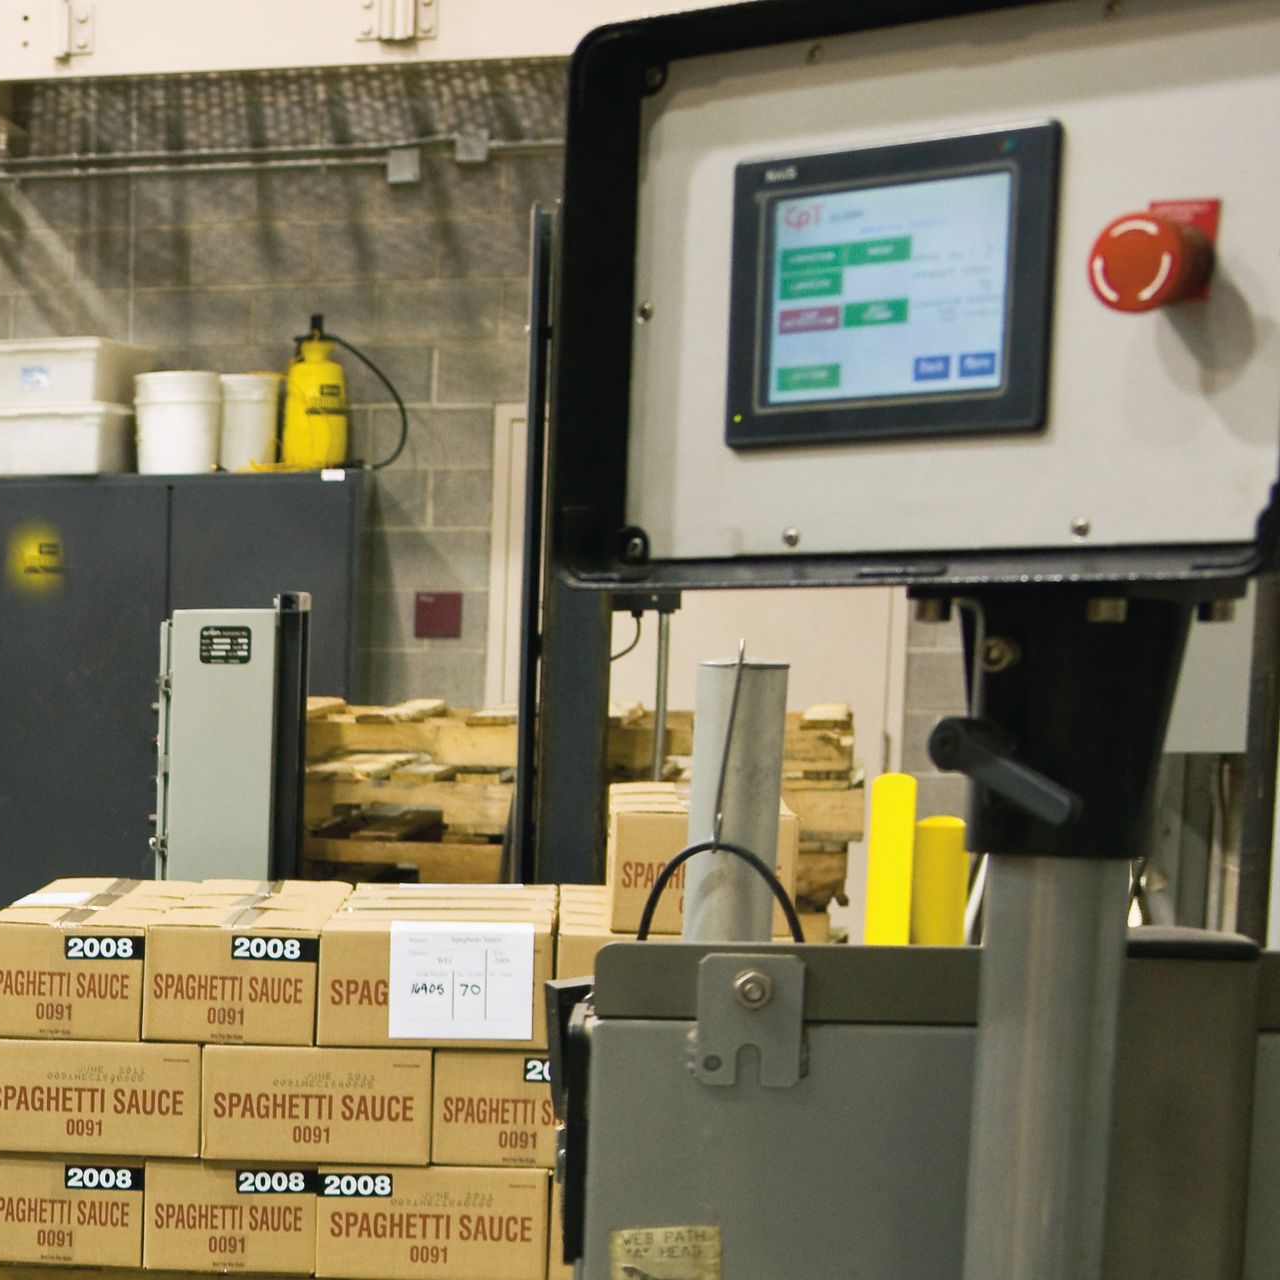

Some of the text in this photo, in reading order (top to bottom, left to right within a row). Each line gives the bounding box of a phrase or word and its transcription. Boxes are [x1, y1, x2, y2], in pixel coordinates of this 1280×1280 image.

[67, 938, 133, 958] 2008
[233, 938, 300, 959] 2008
[76, 972, 130, 1000] SAUCE
[153, 973, 303, 1005] SPAGHETTI SAUCE
[459, 983, 481, 996] 70
[35, 1003, 72, 1021] 0091
[207, 1007, 245, 1025] 0091
[113, 1088, 184, 1116] SAUCE
[213, 1091, 414, 1122] SPAGHETTI SAUCE
[443, 1096, 536, 1125] SPAGHETTI
[66, 1119, 103, 1136] 0091
[293, 1125, 330, 1144] 0091
[498, 1130, 537, 1149] 0091
[67, 1167, 132, 1188] 2008
[238, 1172, 305, 1192] 2008
[324, 1175, 391, 1196] 2008
[77, 1200, 130, 1228] SAUCE
[154, 1203, 303, 1232] SPAGHETTI SAUCE
[330, 1212, 532, 1243] SPAGHETTI SAUCE
[37, 1229, 73, 1247] 0091
[208, 1236, 245, 1254] 0091
[623, 1231, 706, 1246] WEB PATH
[409, 1245, 448, 1264] 0091
